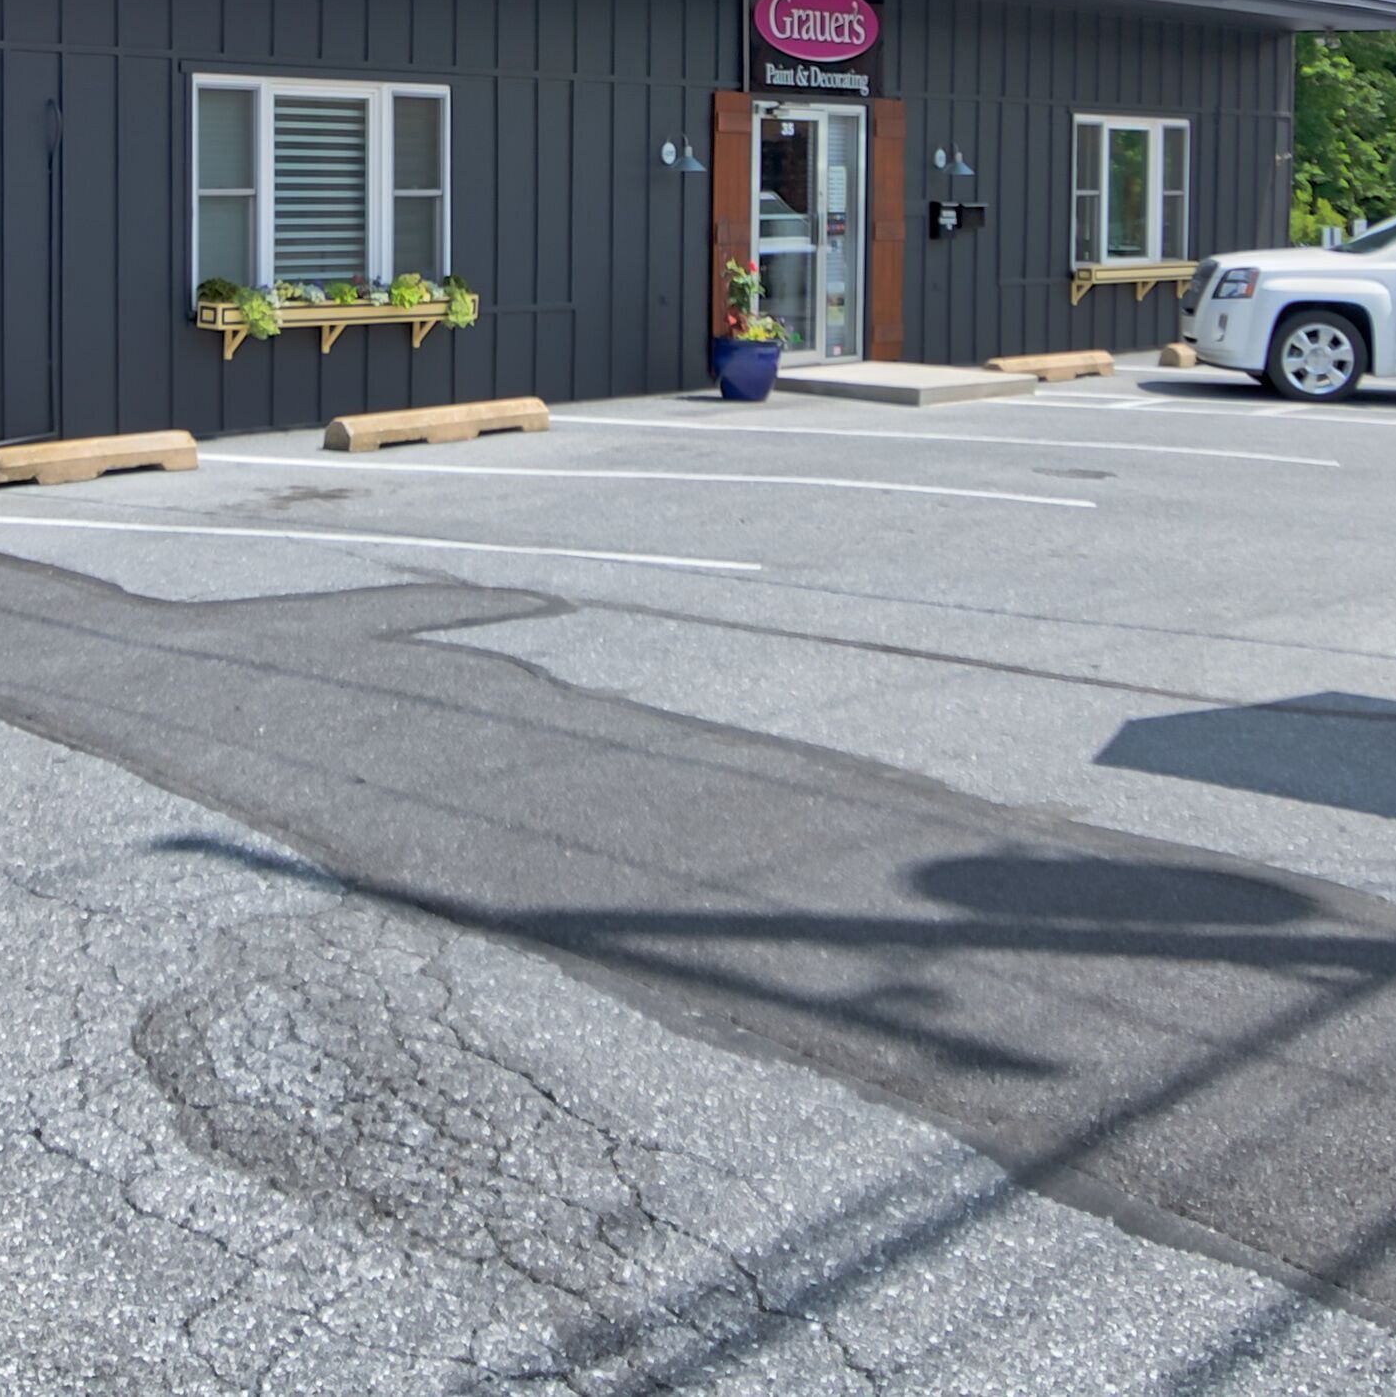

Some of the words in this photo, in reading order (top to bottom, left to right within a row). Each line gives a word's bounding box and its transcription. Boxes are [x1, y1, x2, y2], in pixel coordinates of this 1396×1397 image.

[766, 64, 794, 85] Paint
[796, 65, 809, 86] &
[810, 66, 868, 95] Decorating
